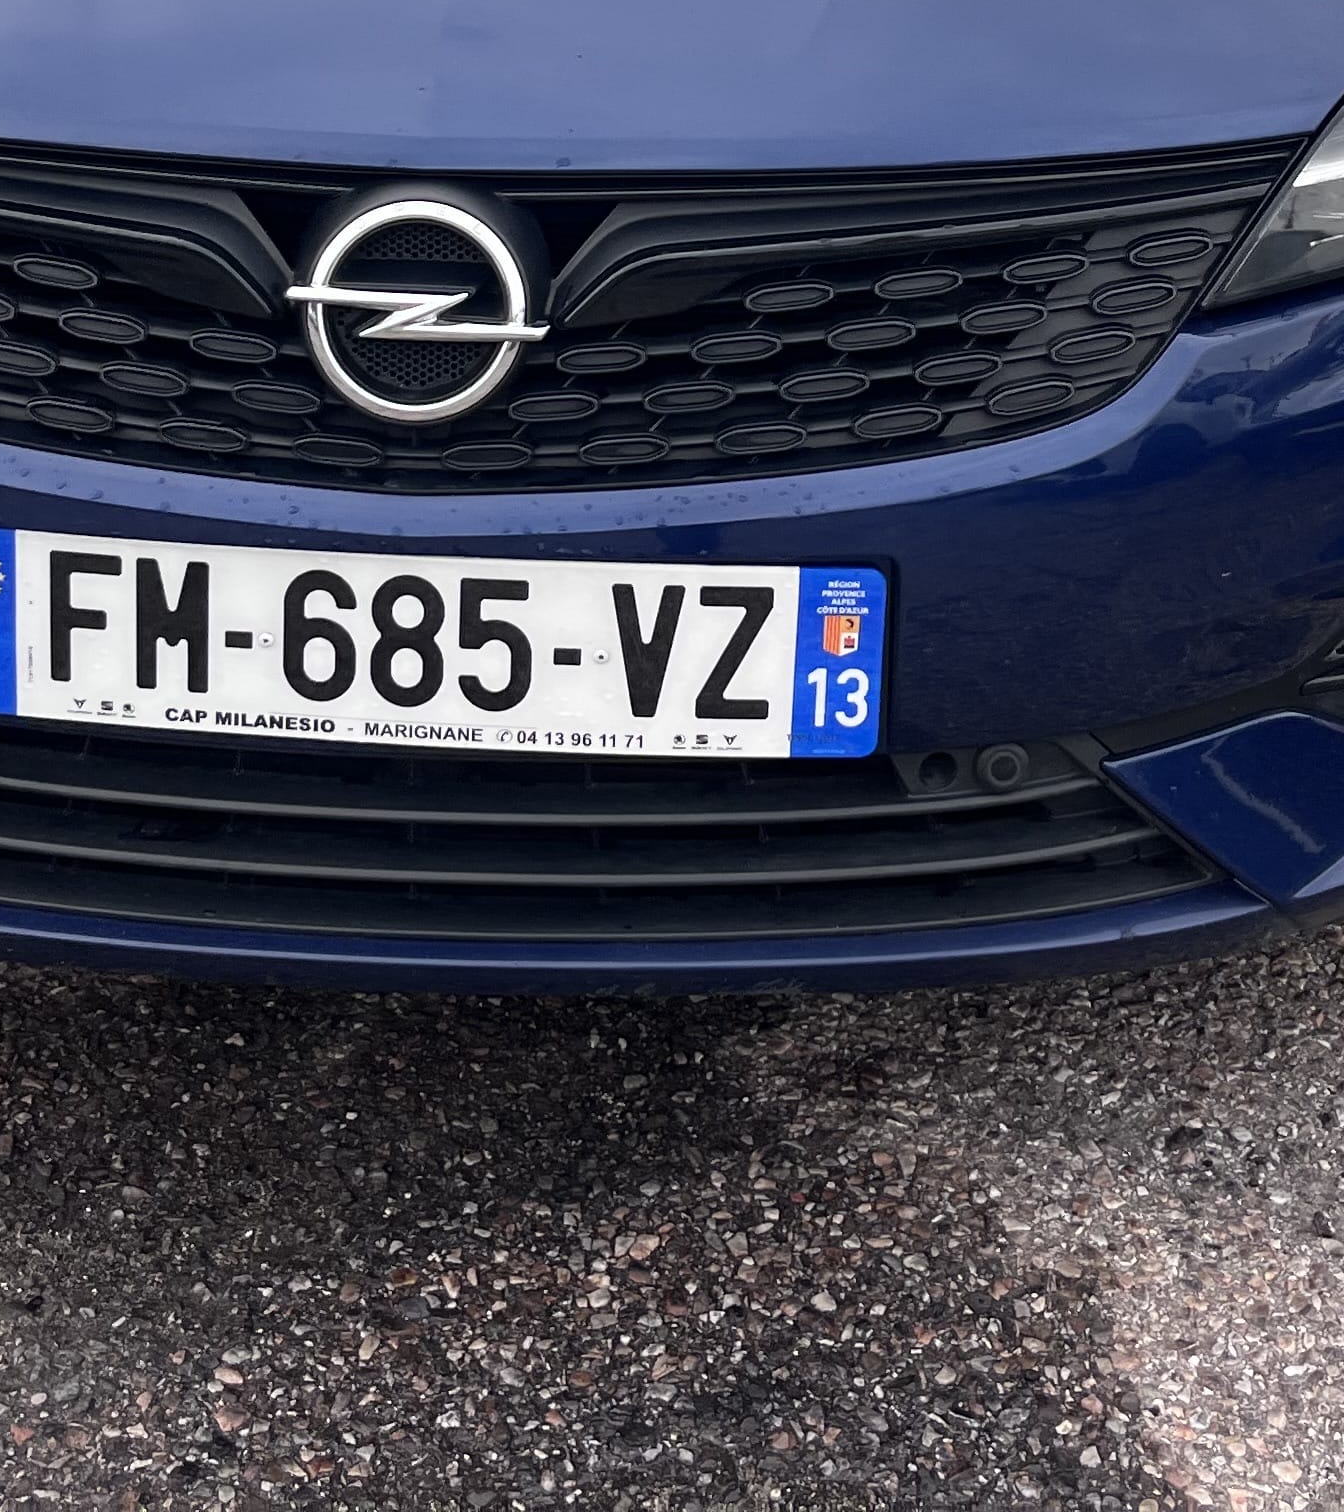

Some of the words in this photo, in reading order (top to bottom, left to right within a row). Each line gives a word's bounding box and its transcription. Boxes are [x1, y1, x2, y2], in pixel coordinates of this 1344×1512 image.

[49, 550, 774, 720] FM-685-VZ
[164, 707, 207, 724] CAP
[215, 710, 336, 734] MILANESIO
[364, 722, 484, 743] MARIGNANE
[516, 730, 537, 745] 04
[545, 731, 565, 746] 13
[571, 732, 592, 747] 96
[598, 733, 617, 748] 11
[624, 734, 644, 749] 71
[807, 667, 870, 728] 13
